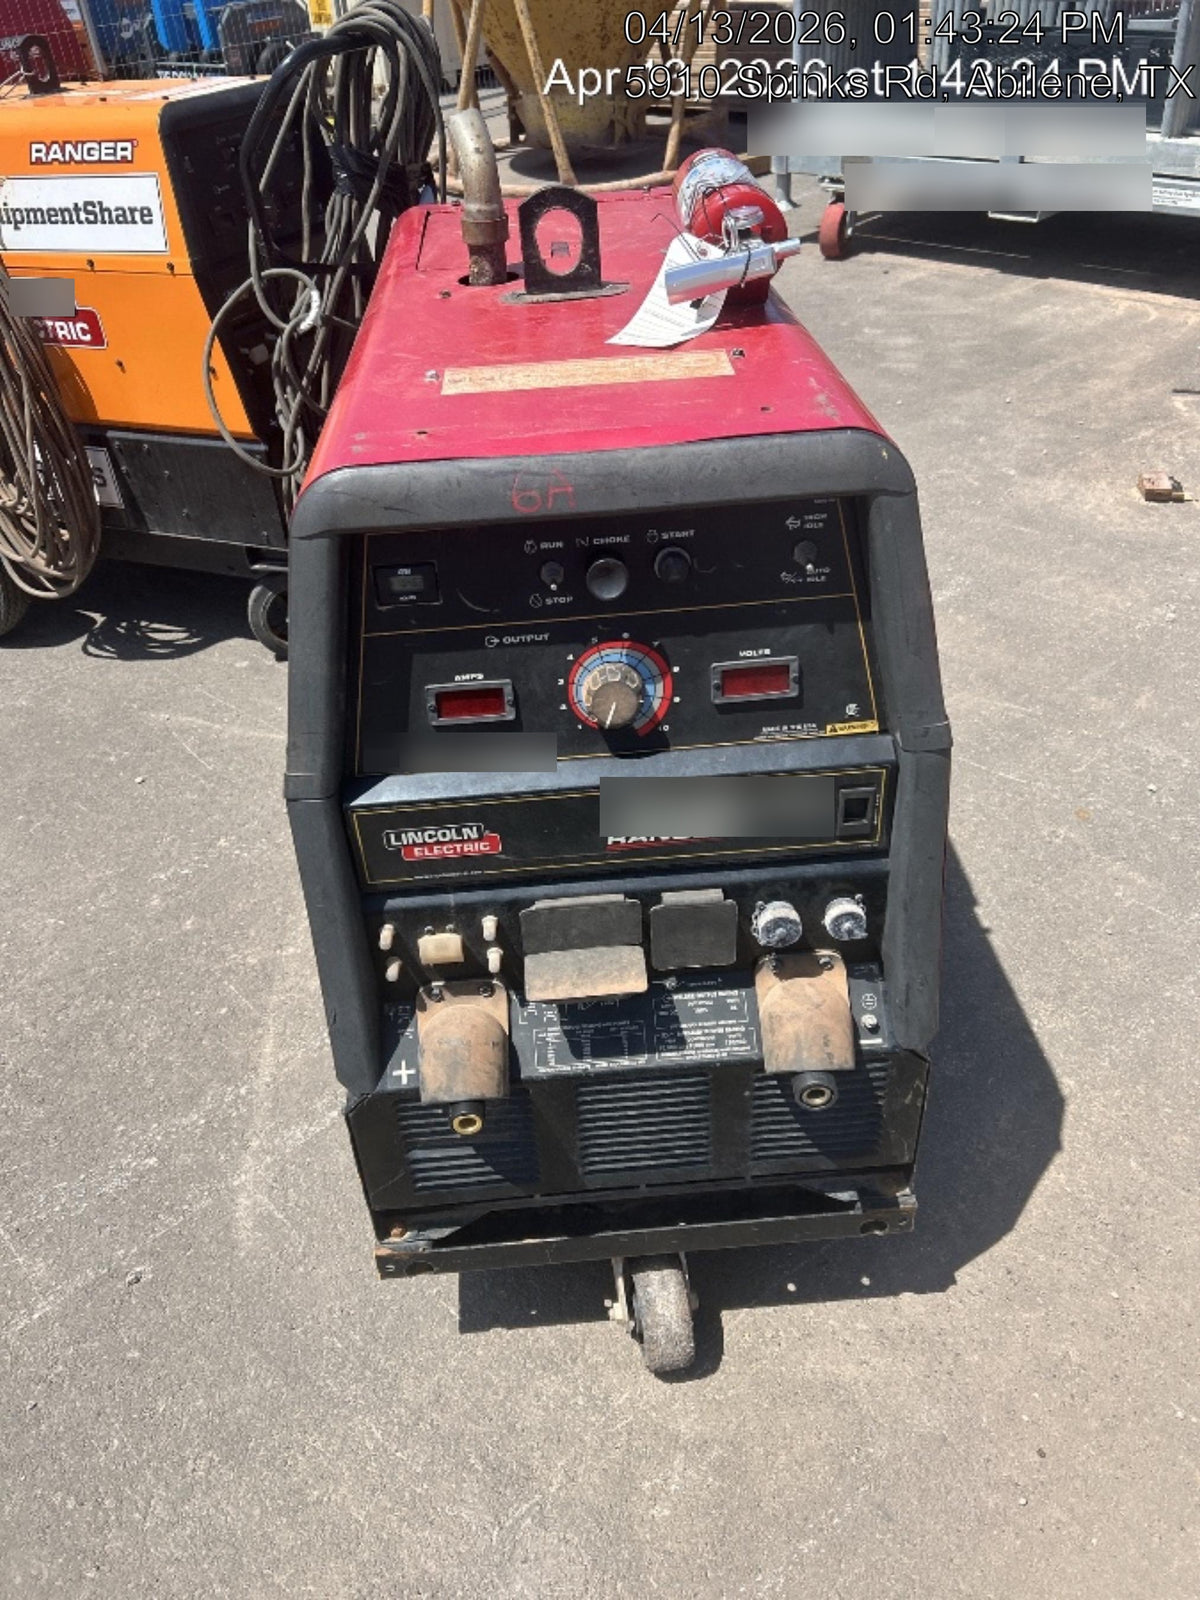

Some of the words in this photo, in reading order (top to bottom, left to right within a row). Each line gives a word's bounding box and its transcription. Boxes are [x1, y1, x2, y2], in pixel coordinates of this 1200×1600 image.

[31, 141, 133, 163] RANGER
[502, 633, 550, 644] OUTPUT
[390, 826, 479, 846] LINCOLN
[413, 841, 491, 858] ELECTRIC
